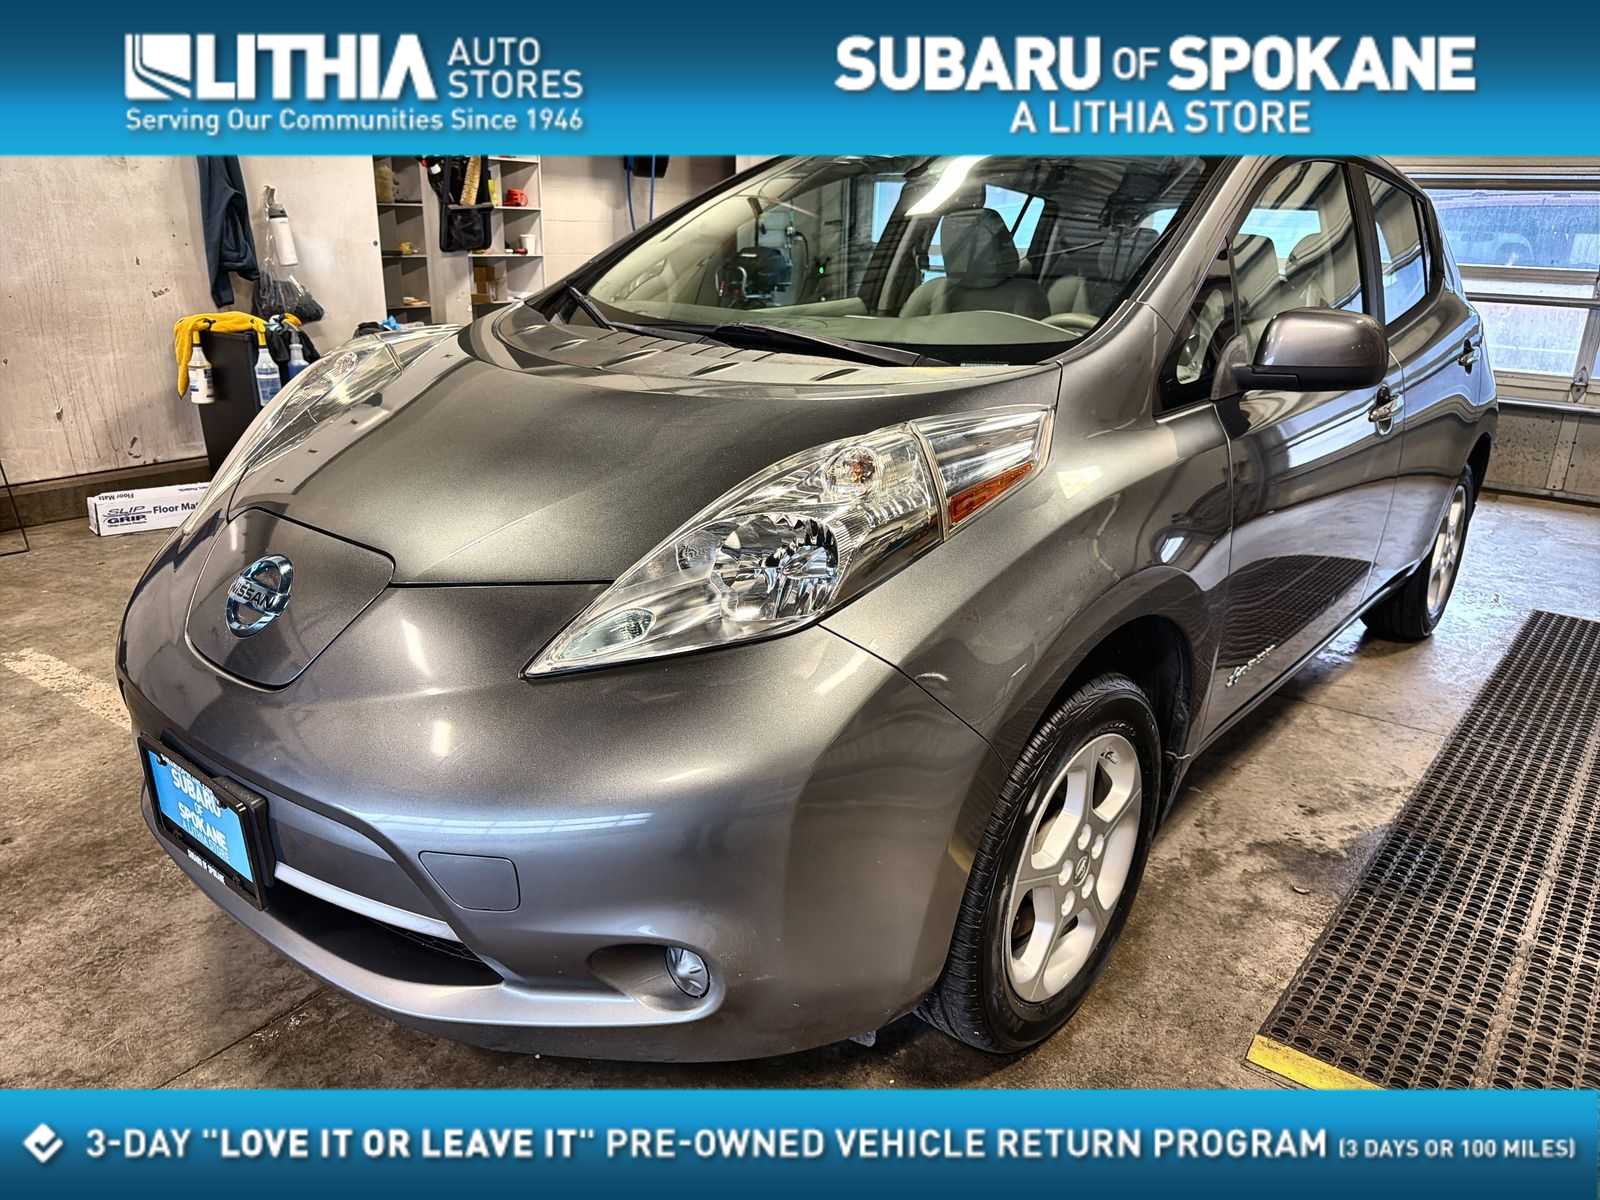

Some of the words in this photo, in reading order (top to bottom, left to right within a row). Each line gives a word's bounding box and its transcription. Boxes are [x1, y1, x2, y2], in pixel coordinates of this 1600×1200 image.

[107, 505, 146, 514] SLIP
[153, 505, 179, 514] Floor
[107, 514, 147, 524] GRIP
[229, 578, 275, 609] NISSAN
[170, 768, 222, 818] SUBARU
[177, 801, 227, 851] SPOKANE
